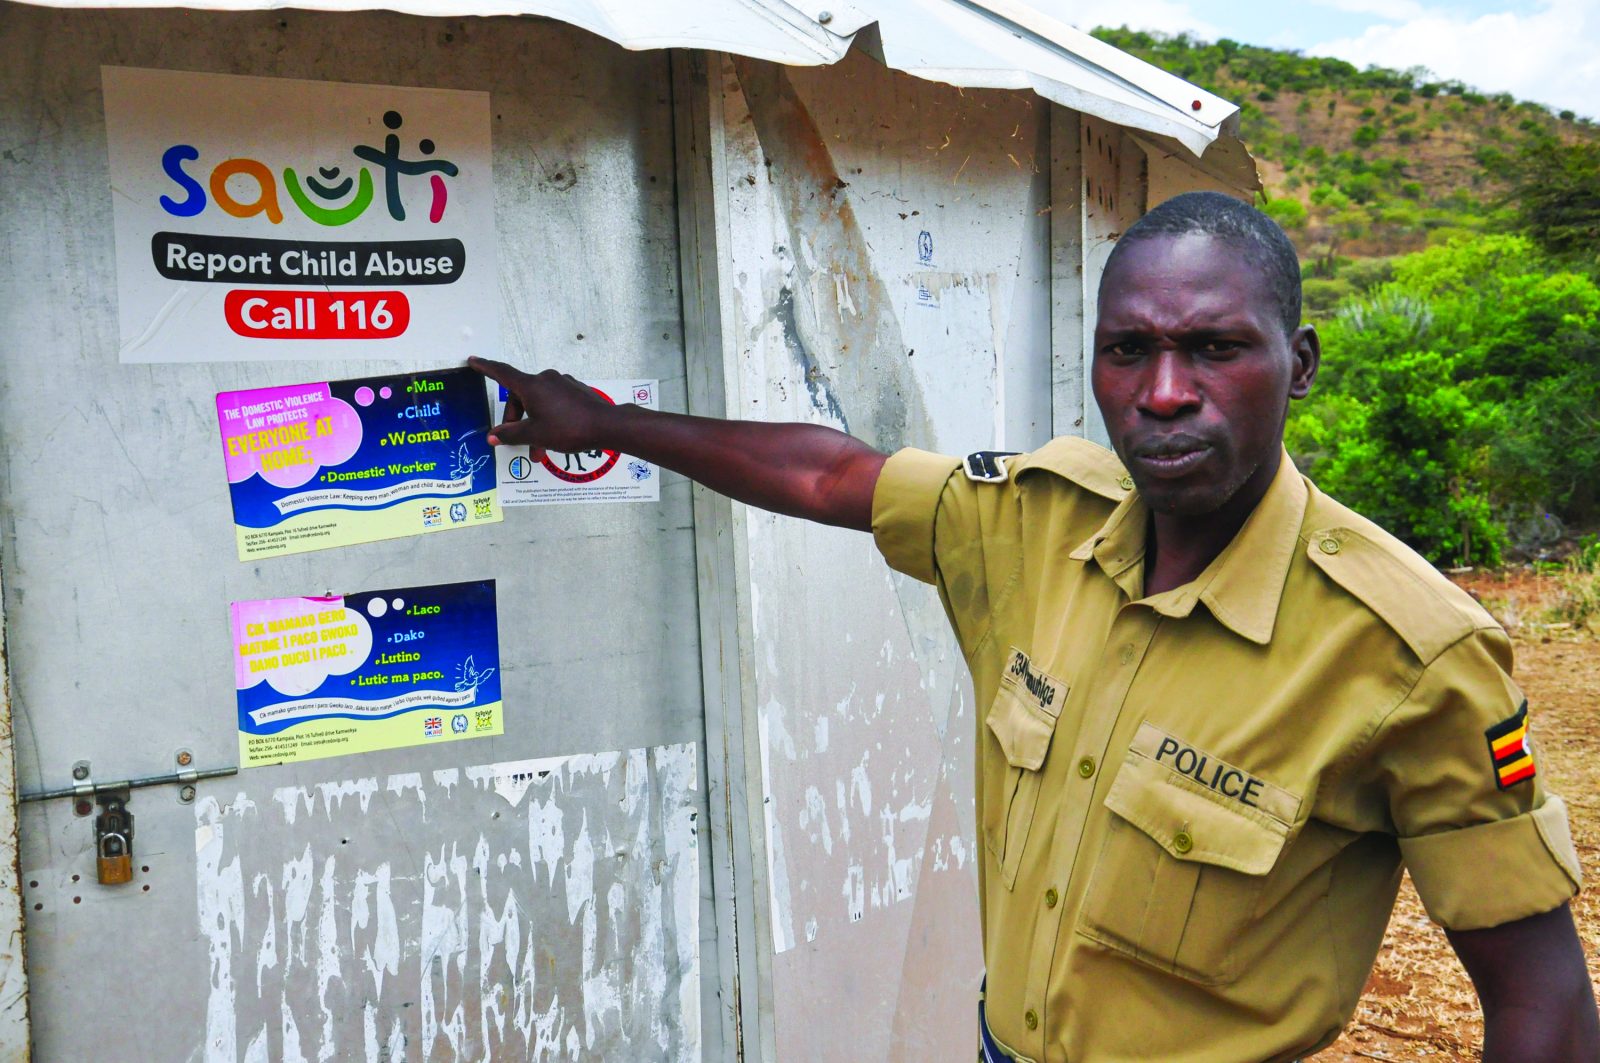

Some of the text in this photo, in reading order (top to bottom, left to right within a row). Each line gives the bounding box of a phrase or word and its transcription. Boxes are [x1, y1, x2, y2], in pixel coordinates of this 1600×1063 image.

[159, 132, 459, 227] sauti
[166, 243, 454, 279] Report Child Abuse
[240, 298, 394, 330] Call 116
[414, 380, 444, 393] Man
[224, 392, 324, 420] THE DOMESTIC VIOLENCE
[405, 402, 440, 418] Child
[245, 408, 308, 430] LAW PROTECTS
[227, 416, 333, 456] EVERYONE AT
[388, 430, 450, 446] Woman
[260, 445, 314, 472] HOME;
[328, 462, 437, 482] Domestic Worker
[413, 605, 441, 616] Laco
[246, 608, 346, 637] CIK MAMAKO GERO
[290, 631, 318, 647] PACO
[321, 624, 358, 642] GWOKO
[394, 630, 425, 644] Dako
[250, 656, 279, 672] DANO
[282, 650, 310, 667] DUCU
[381, 651, 421, 664] Lutino
[358, 671, 444, 686] Lutic ma paco.
[1155, 737, 1265, 808] POLICE
